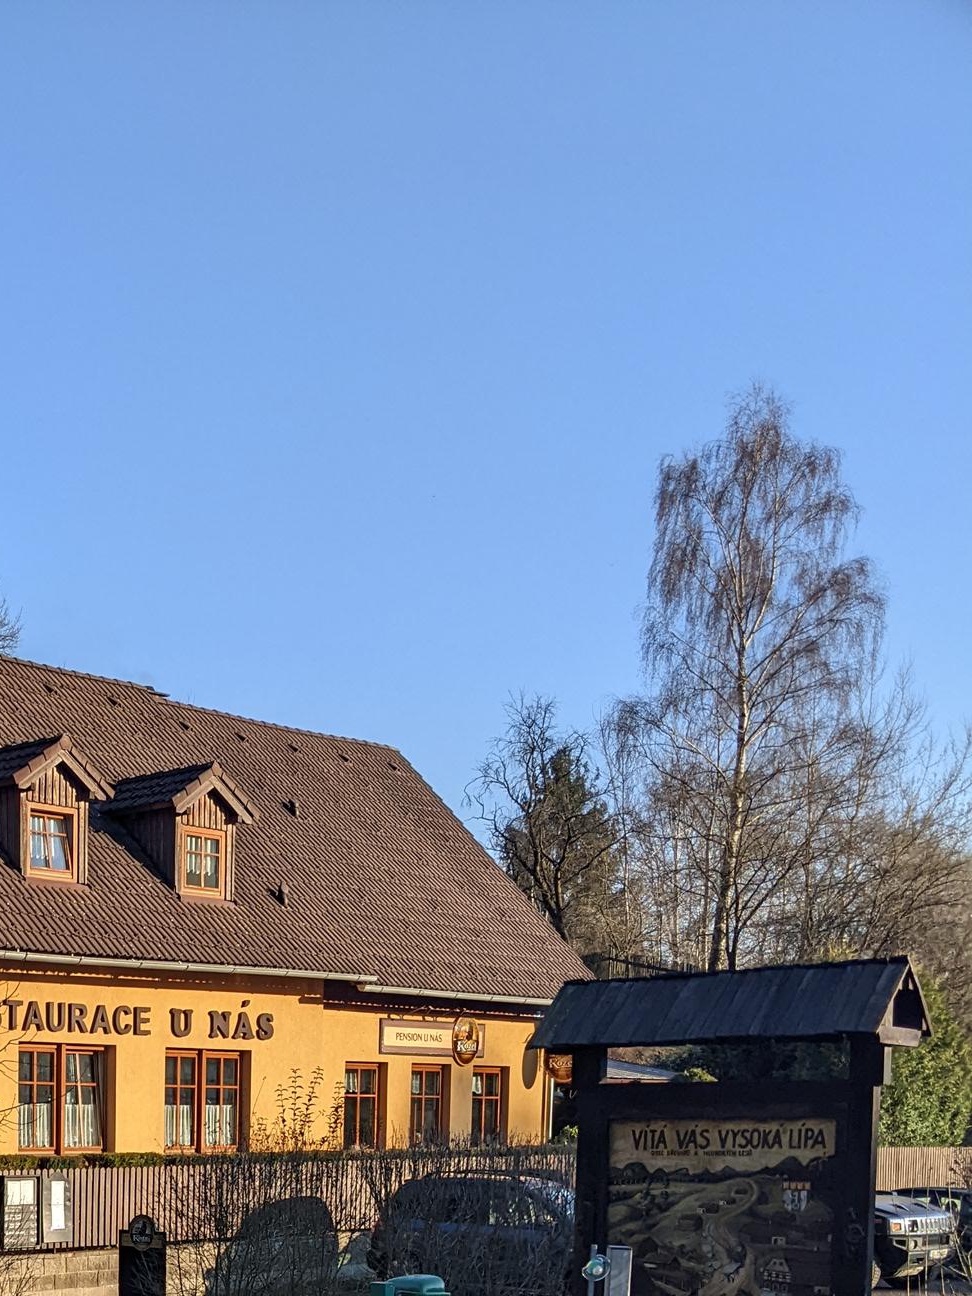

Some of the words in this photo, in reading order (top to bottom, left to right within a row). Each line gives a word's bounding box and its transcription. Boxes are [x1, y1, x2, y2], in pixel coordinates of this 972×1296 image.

[169, 1007, 193, 1037] U
[208, 1000, 275, 1040] NÁS
[395, 1032, 423, 1042] PENSION
[424, 1033, 429, 1042] U
[548, 1057, 573, 1069] Koze
[631, 1124, 668, 1150] VÍTÁ
[676, 1124, 711, 1150] VÁS
[718, 1123, 784, 1150] VYSOKÁ
[788, 1123, 827, 1150] LÍPA
